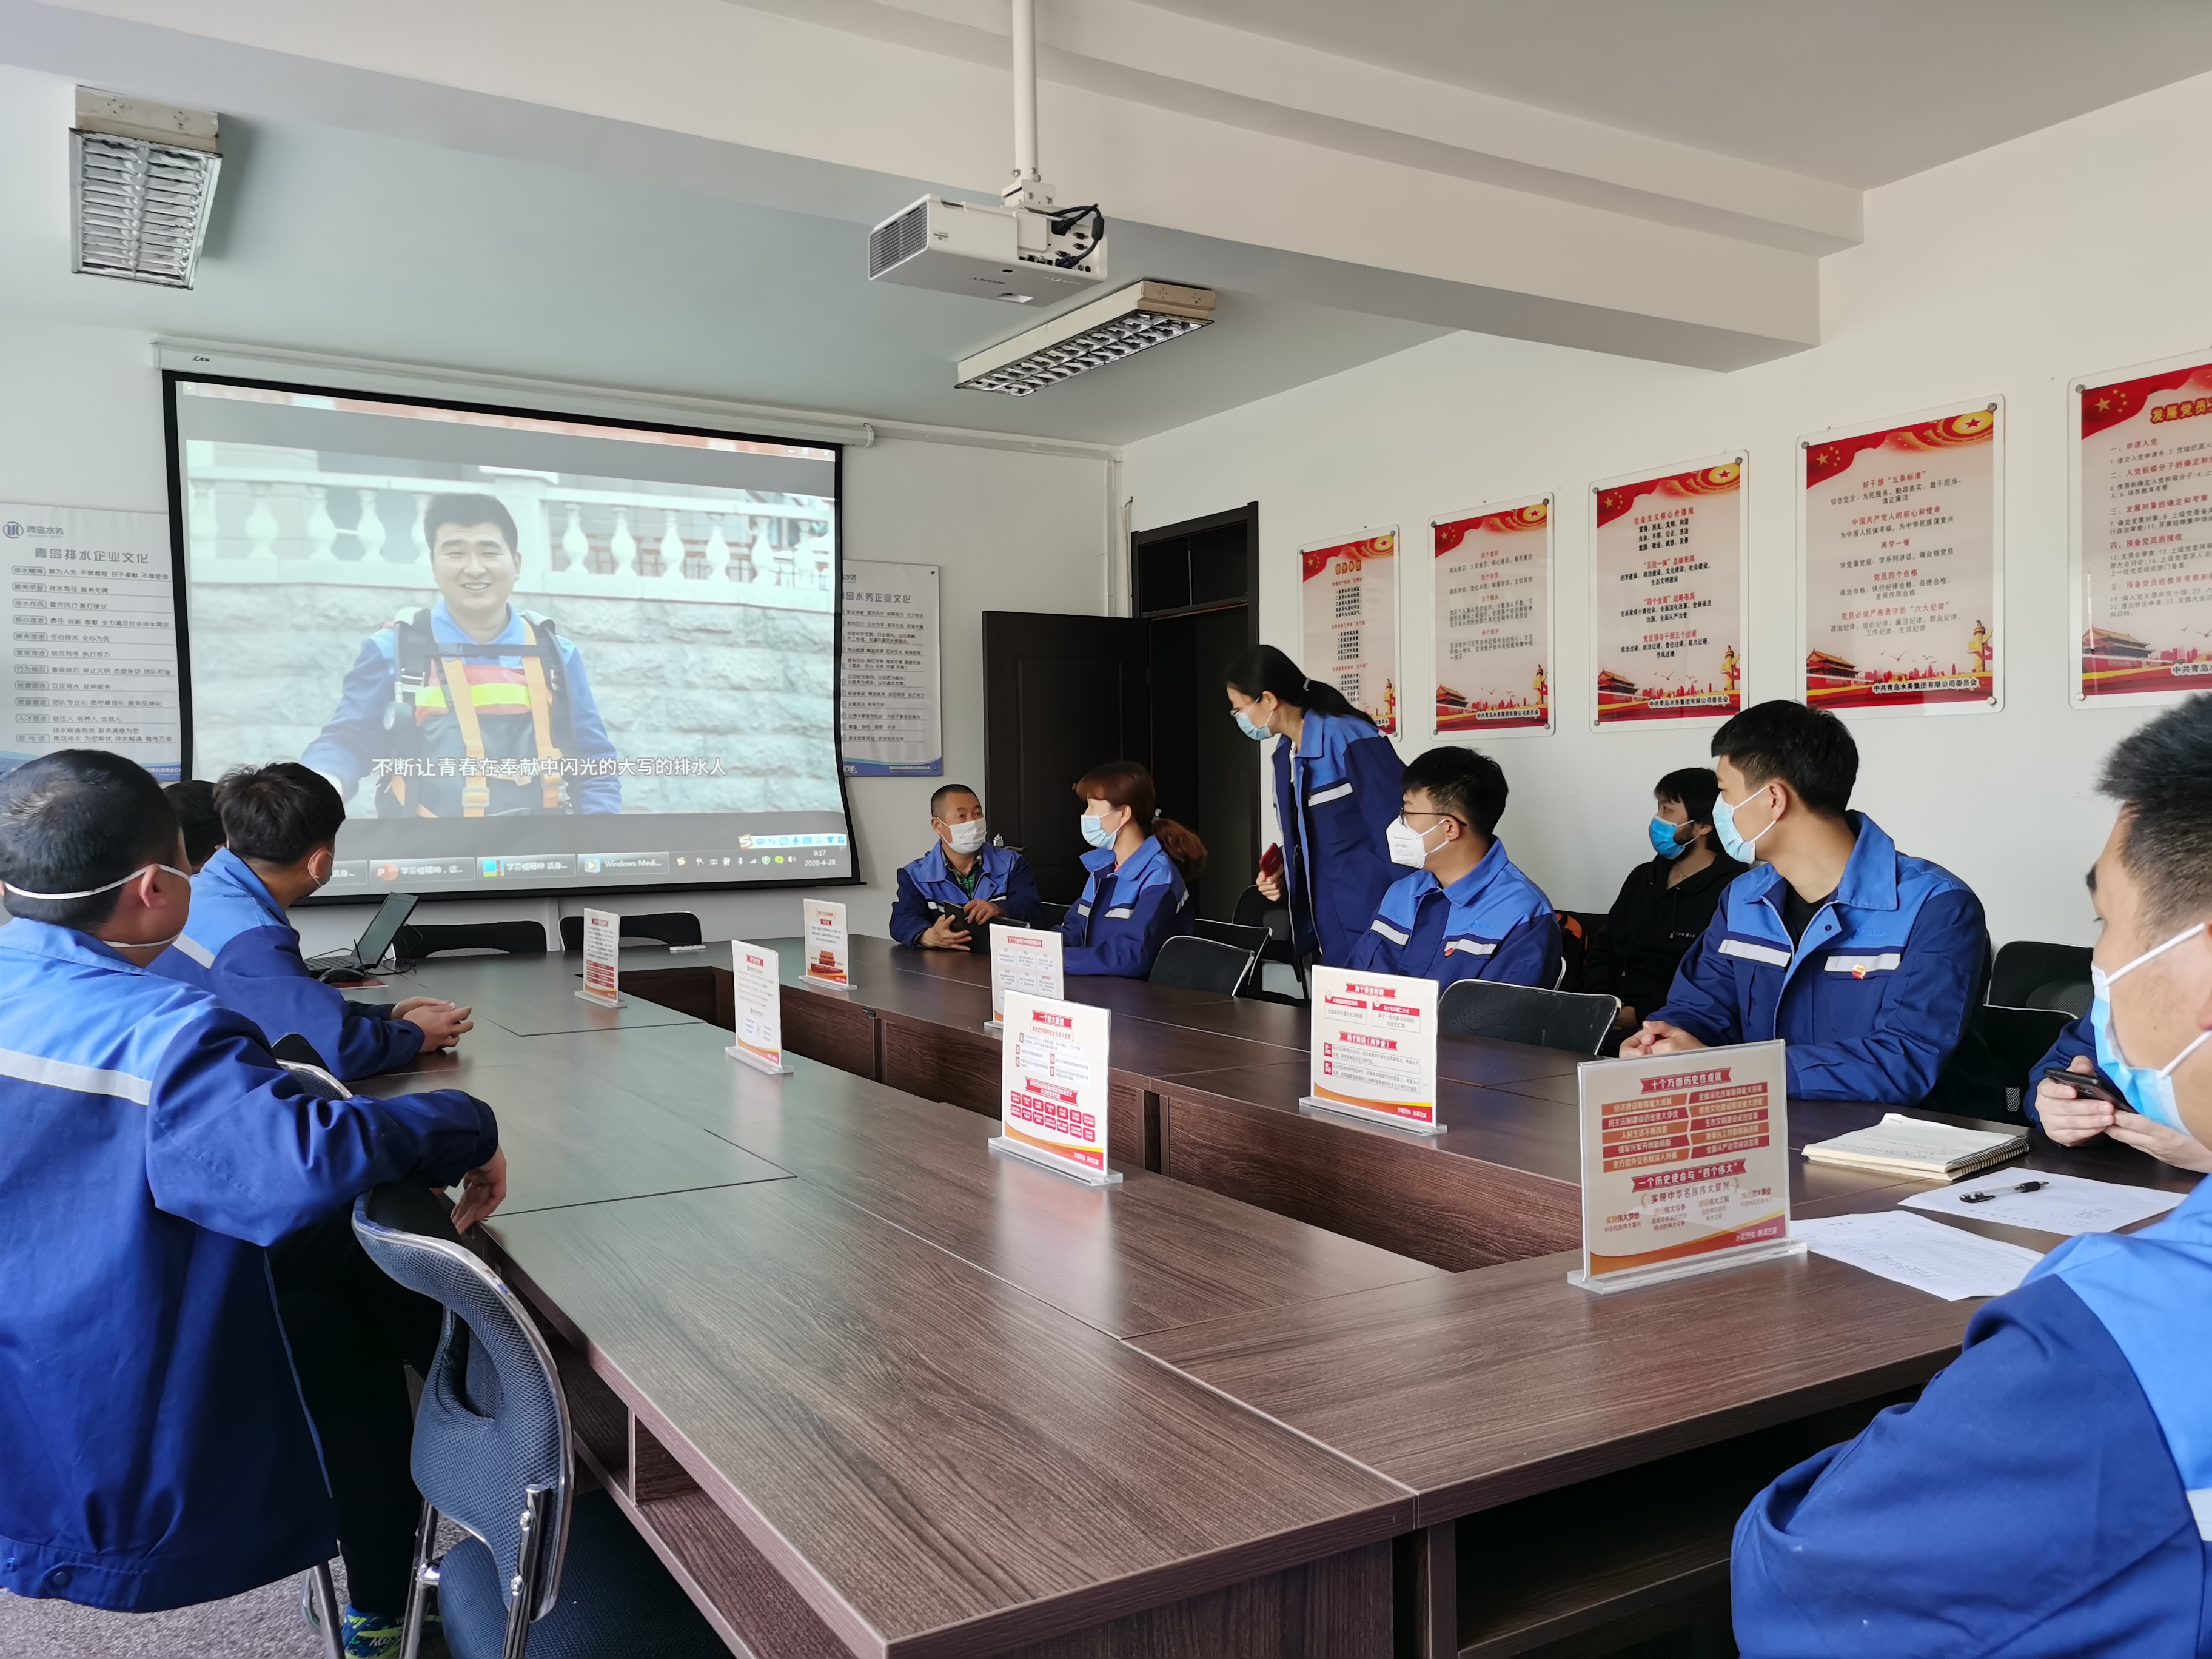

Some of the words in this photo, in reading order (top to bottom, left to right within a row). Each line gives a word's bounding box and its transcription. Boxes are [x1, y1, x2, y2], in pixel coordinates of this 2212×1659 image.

[2110, 438, 2158, 451] 一、申请入党
[1882, 494, 1909, 504] 清正廉洁
[1634, 507, 1694, 525] 社会主义核心价值观
[1852, 505, 1940, 526] 中国共产党人的初心和使命
[1840, 515, 1954, 539] 为中国人民谋幸福，为中华民族谋复兴
[1881, 538, 1910, 549] 两学一做
[2110, 533, 2182, 549] 四、预备党员的接收
[35, 547, 149, 564] 青岛排水企业文化
[1651, 576, 1678, 586] 生态文明建设
[1874, 569, 1917, 581] 党员四个合格
[842, 591, 911, 603] 岛水务企业文化
[1875, 589, 1915, 600] 发挥作用合格
[1866, 624, 1926, 637] 工作纪律、生活纪律
[1874, 679, 1977, 691] 中共青岛水务集团有限公司委员会
[1649, 695, 1728, 707] 中共青岛水务集团有限公司委员会
[372, 756, 727, 777] 不断让青春在奉献中闪光的大写的排水人
[605, 859, 636, 868] Windows
[1651, 1072, 1721, 1090] 十个方面历史性成就
[1621, 1125, 1667, 1139] 人民生活不断改善
